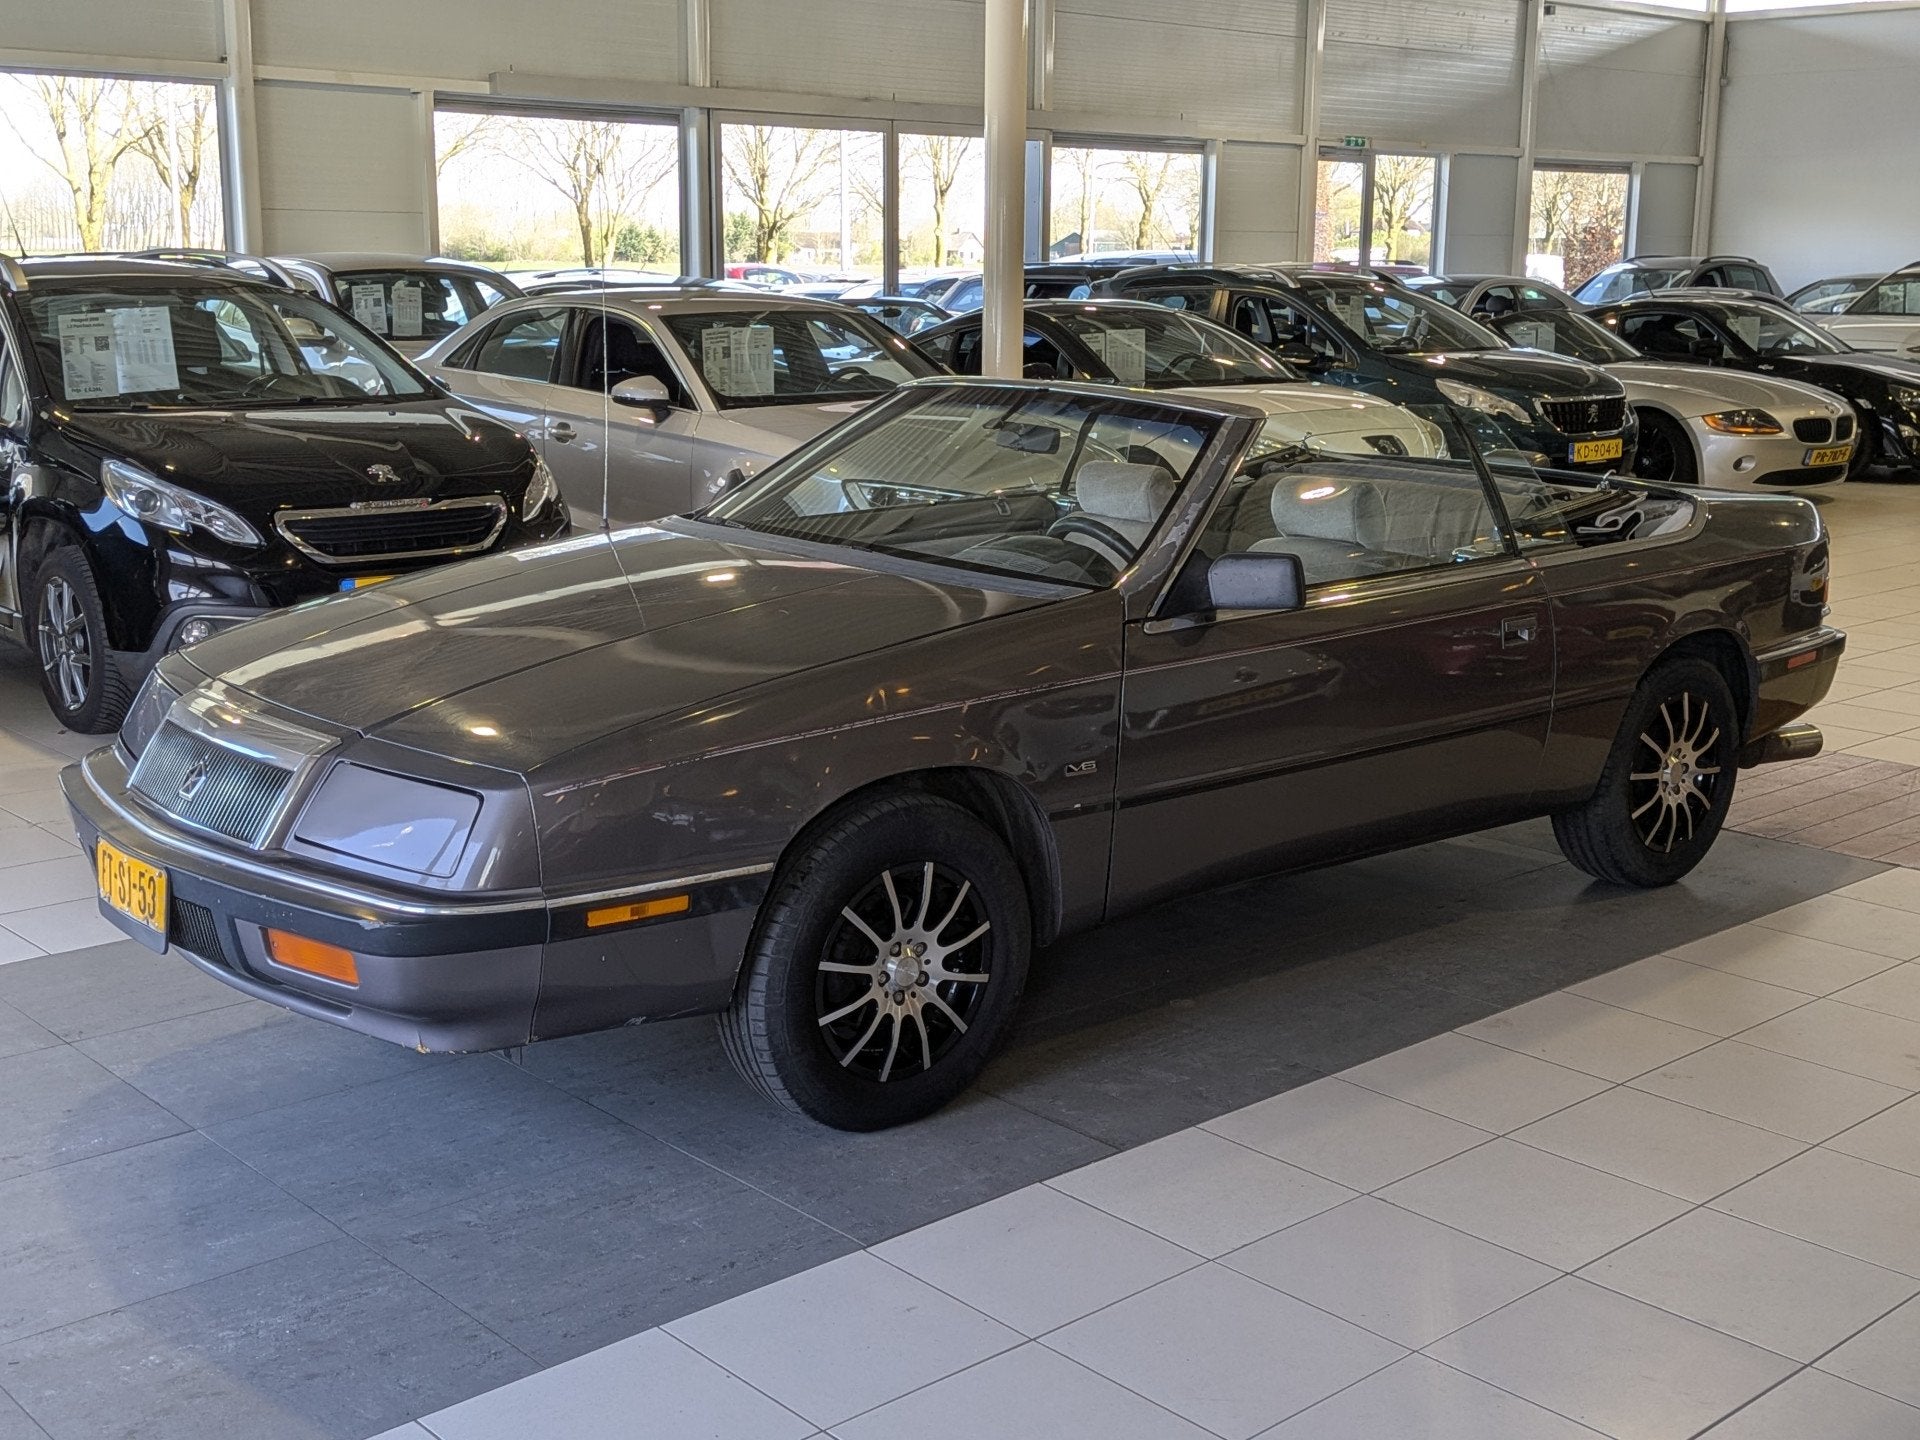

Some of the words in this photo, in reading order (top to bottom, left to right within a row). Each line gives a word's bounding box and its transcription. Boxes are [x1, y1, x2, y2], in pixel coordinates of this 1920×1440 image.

[1576, 441, 1620, 460] KD-904-X
[1068, 760, 1096, 772] V6
[102, 848, 157, 920] FT-SJ-53
